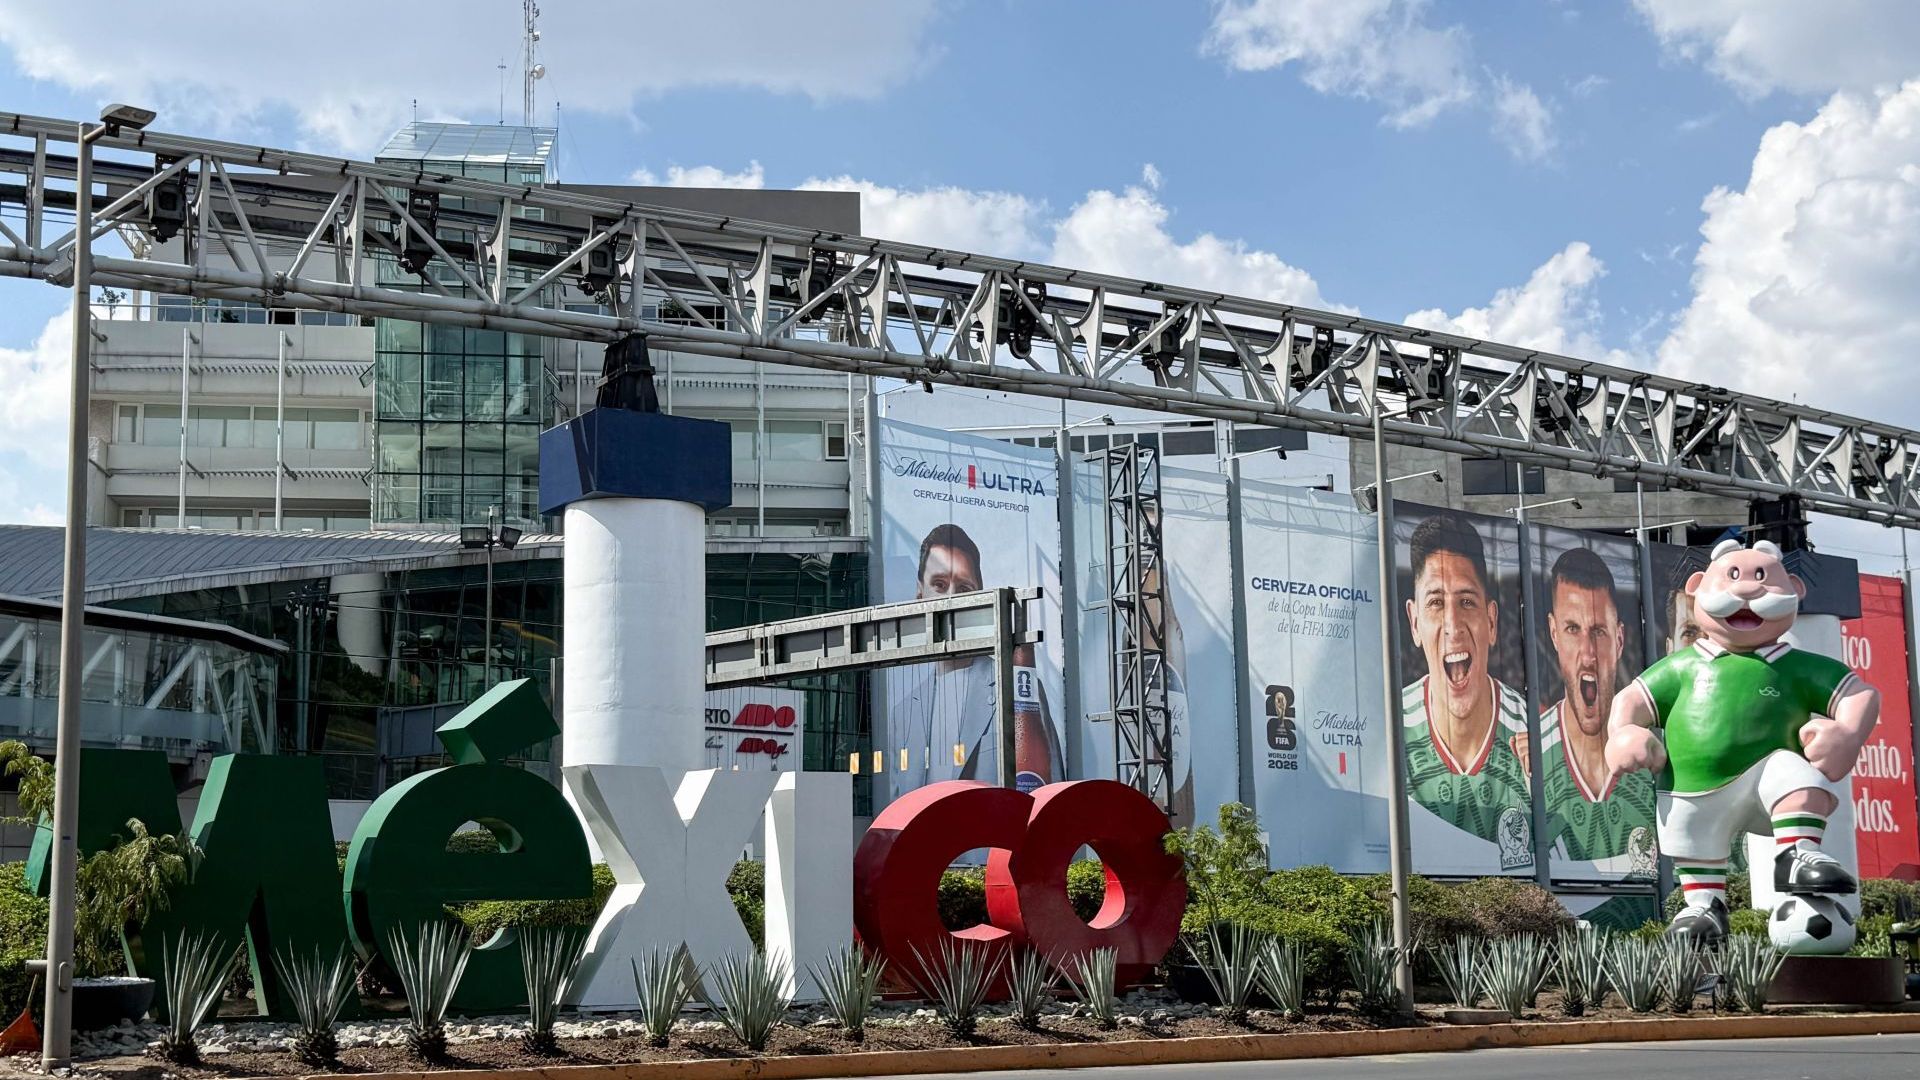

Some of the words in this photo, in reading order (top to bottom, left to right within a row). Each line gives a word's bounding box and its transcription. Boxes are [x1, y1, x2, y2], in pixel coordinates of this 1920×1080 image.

[894, 456, 963, 484] Michelob
[982, 471, 1046, 497] ULTRA
[913, 488, 955, 503] CERVEZA
[955, 495, 986, 507] LIGERA
[986, 499, 1030, 513] SUPERIOR
[1251, 577, 1317, 597] CERVEZA
[1318, 585, 1373, 603] OFICIAL
[1267, 597, 1279, 612] de
[1281, 598, 1290, 613] la
[1292, 599, 1316, 619] Copa
[1317, 602, 1358, 621] Mundial
[1277, 618, 1289, 633] de
[1290, 619, 1300, 634] la
[1301, 620, 1324, 636] FIFA
[1324, 623, 1350, 639] 2026
[1840, 625, 1871, 671] ico
[704, 708, 731, 725] RTO
[733, 703, 796, 729] ADO
[1312, 710, 1368, 731] Michelob
[1275, 736, 1290, 745] FIFA
[1322, 733, 1363, 747] ULTRA
[1267, 752, 1286, 760] WORLD
[1268, 759, 1298, 771] 2026
[1850, 738, 1907, 785] ento,
